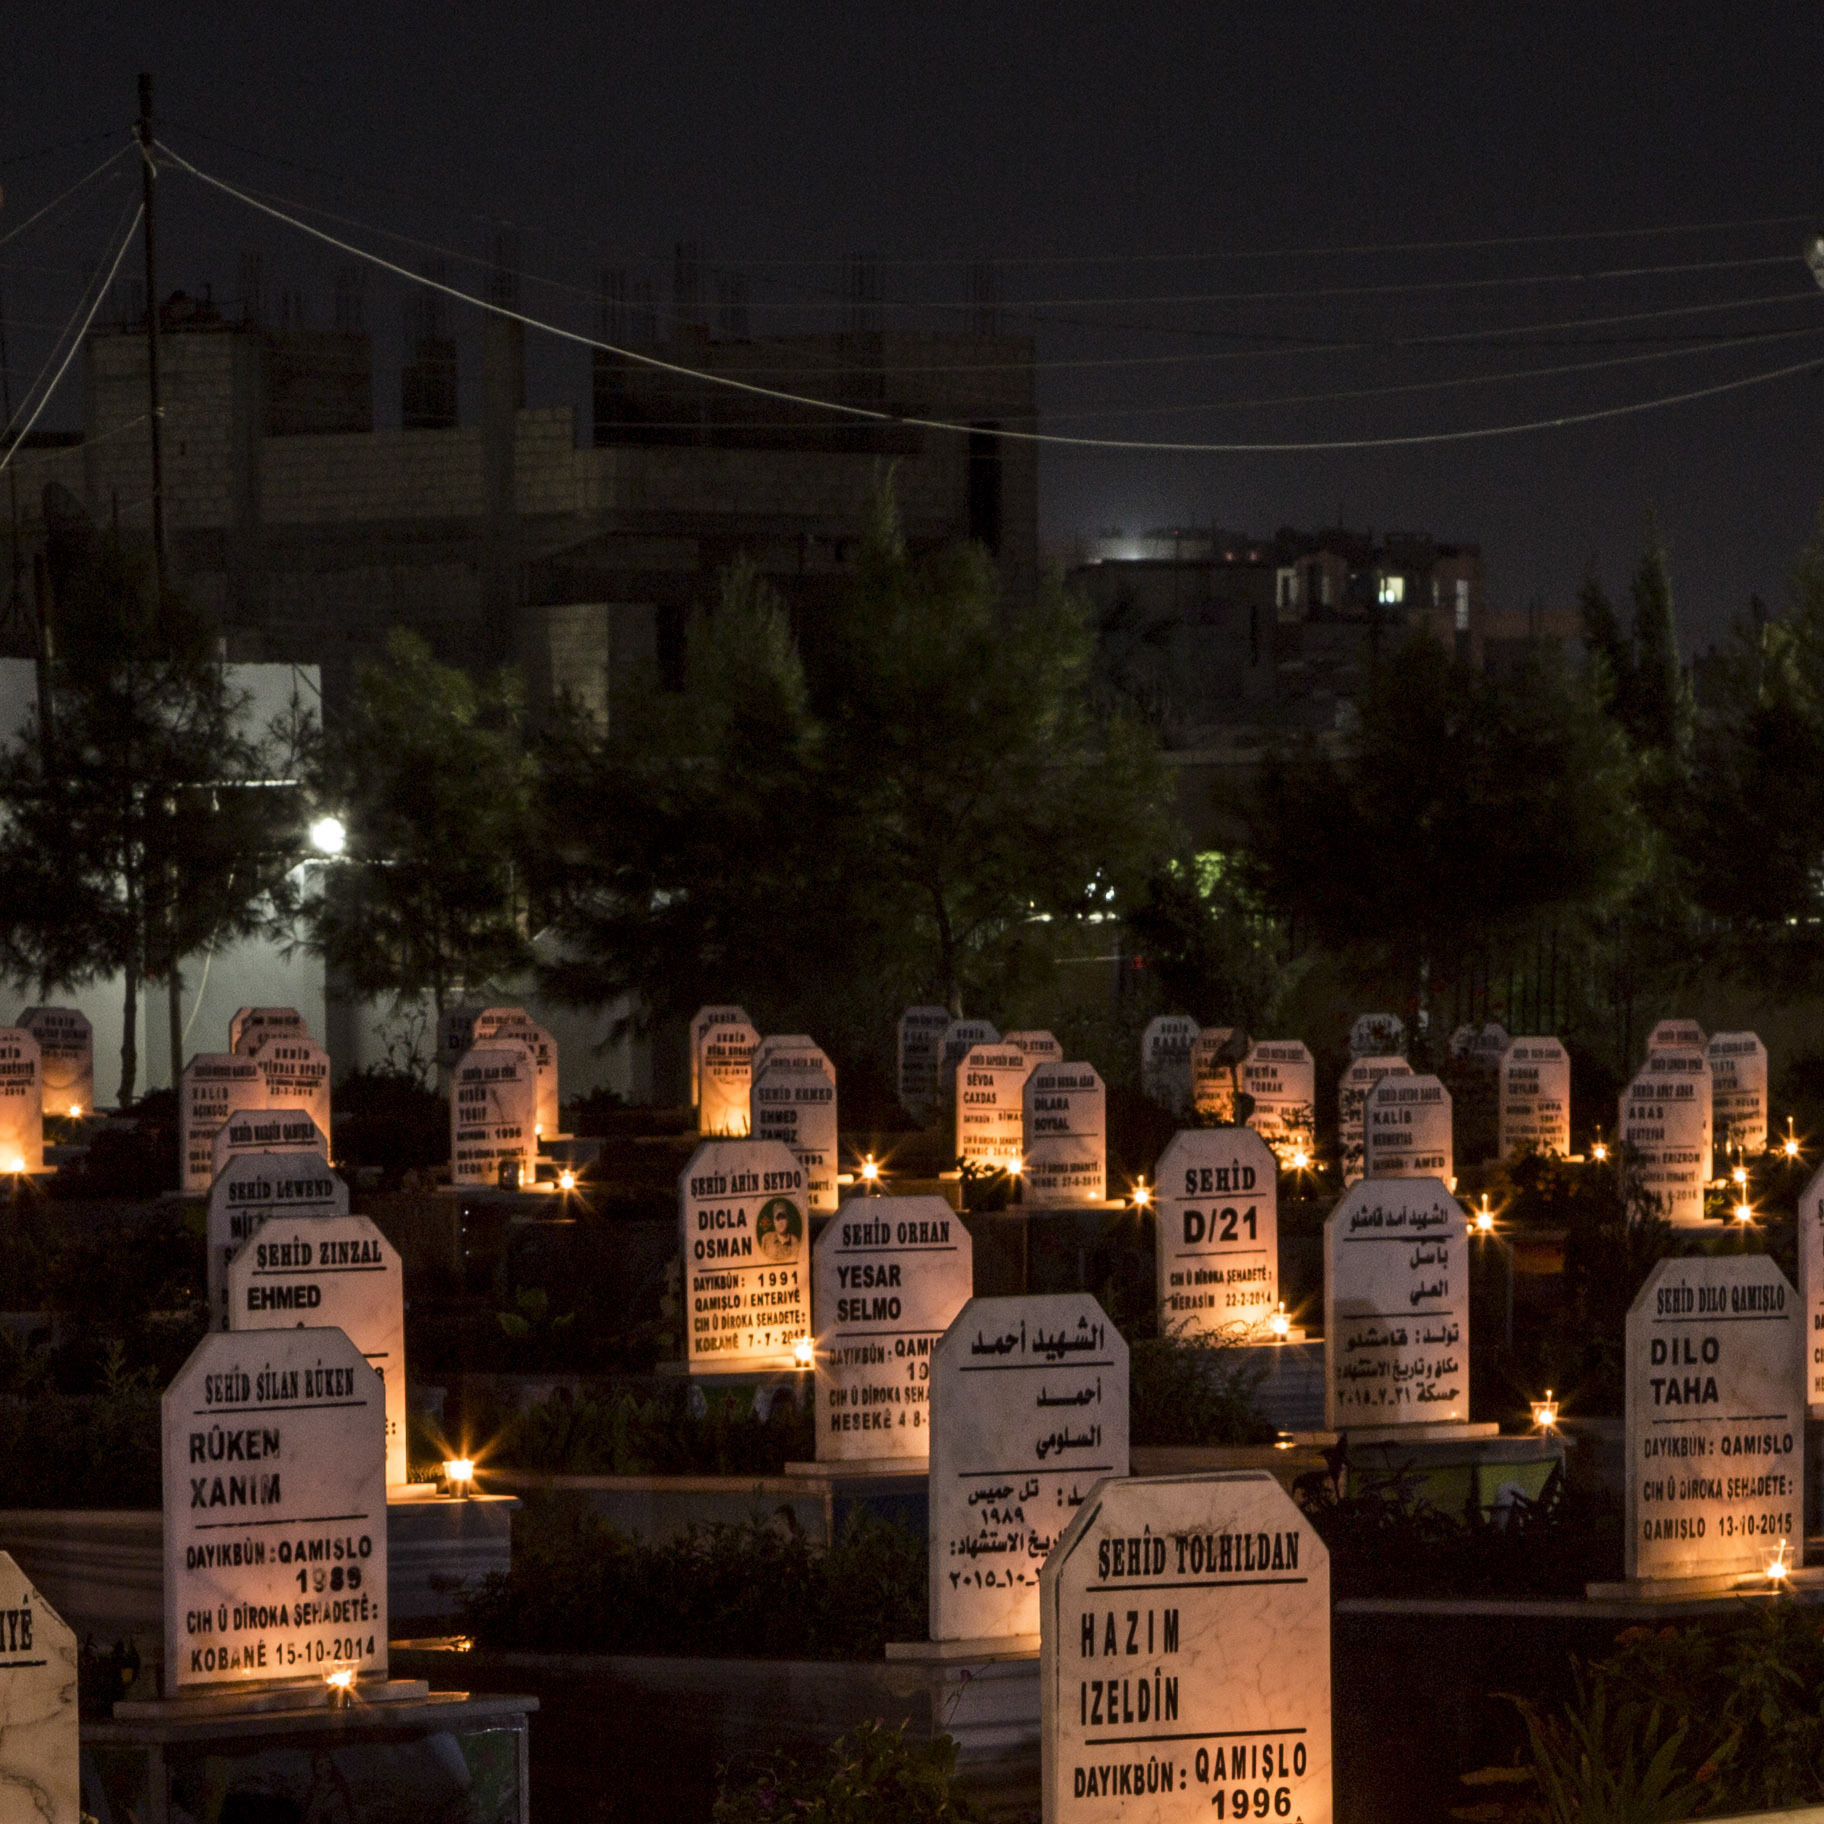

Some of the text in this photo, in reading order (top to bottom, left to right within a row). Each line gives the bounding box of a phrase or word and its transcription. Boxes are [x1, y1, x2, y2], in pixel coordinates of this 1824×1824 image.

[699, 1208, 746, 1230] DICLA
[1183, 1206, 1257, 1244] D/21
[694, 1238, 752, 1260] OSMAN
[838, 1266, 901, 1288] YESAR
[247, 1285, 320, 1309] EHMED
[837, 1298, 901, 1321] SELMO
[1651, 1337, 1720, 1365] DILO
[1651, 1377, 1719, 1404] TAHA
[190, 1474, 281, 1508] XANIM
[1098, 1524, 1299, 1581] ŞEHÎD TOLHILDAN
[296, 1567, 362, 1592] 1989
[1081, 1609, 1179, 1657] HAZIM
[276, 1637, 375, 1664] 15-10-2014
[1081, 1667, 1178, 1726] IZELDÎN
[1195, 1743, 1307, 1784] QAMIŞLO
[1212, 1787, 1291, 1819] 1996
